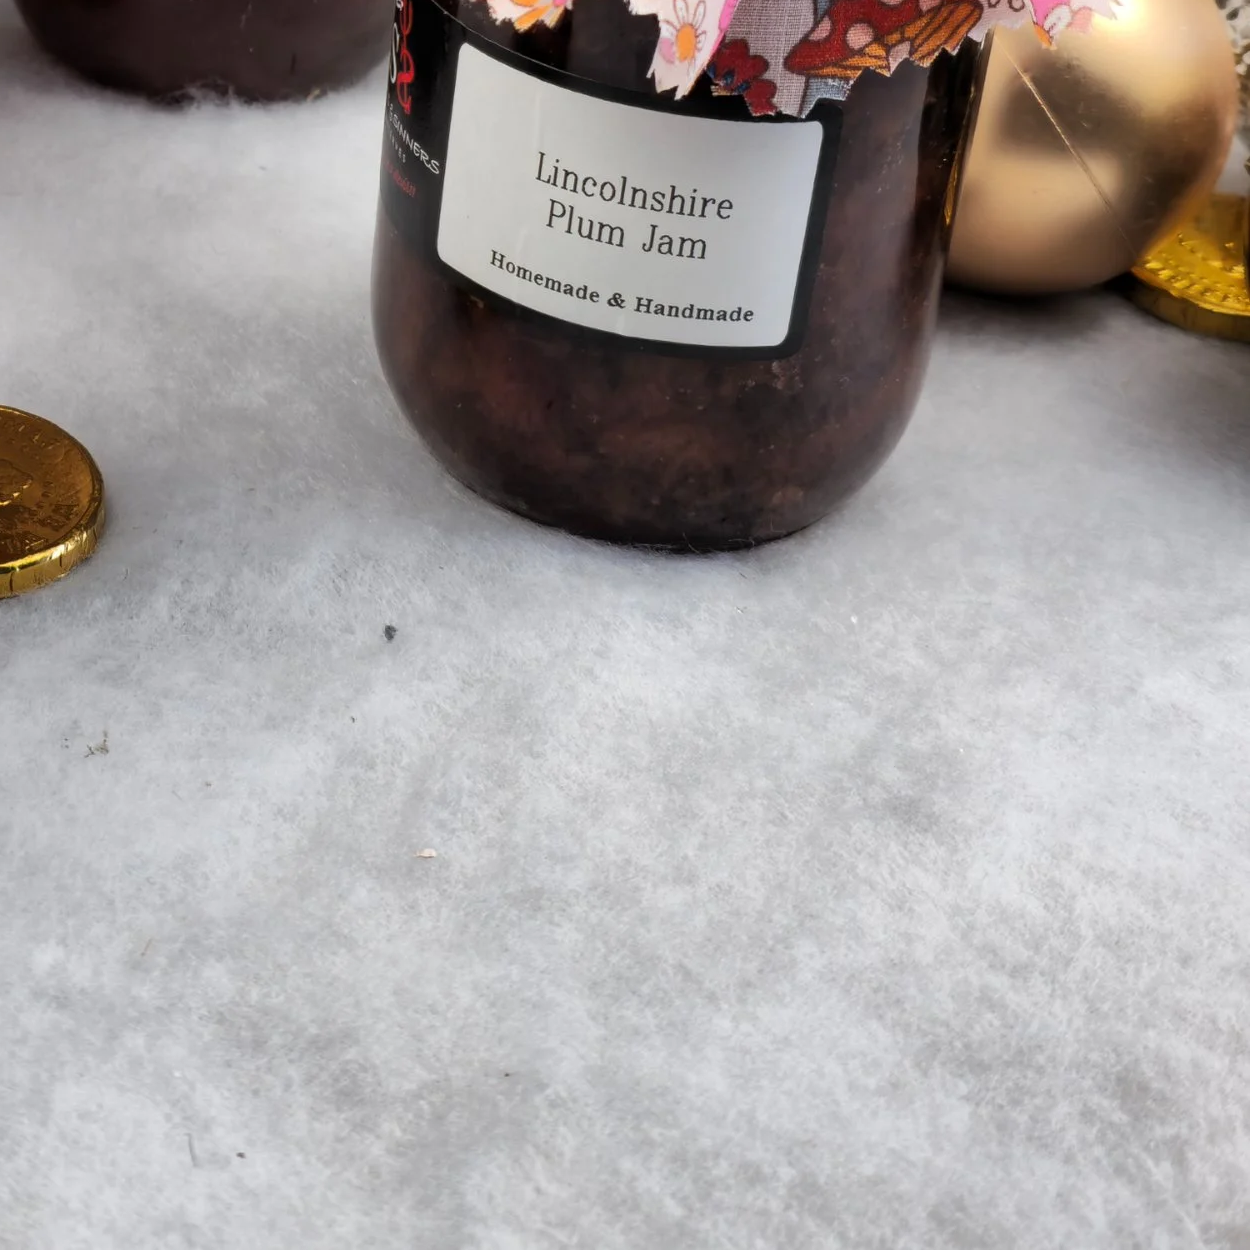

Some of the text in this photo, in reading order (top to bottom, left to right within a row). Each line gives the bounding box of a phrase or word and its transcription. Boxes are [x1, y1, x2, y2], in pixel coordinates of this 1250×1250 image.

[393, 114, 440, 175] SINNERS
[535, 151, 734, 220] Lincolnshire
[546, 198, 708, 260] Plum Jam
[489, 250, 754, 322] Homemade & Handmade
